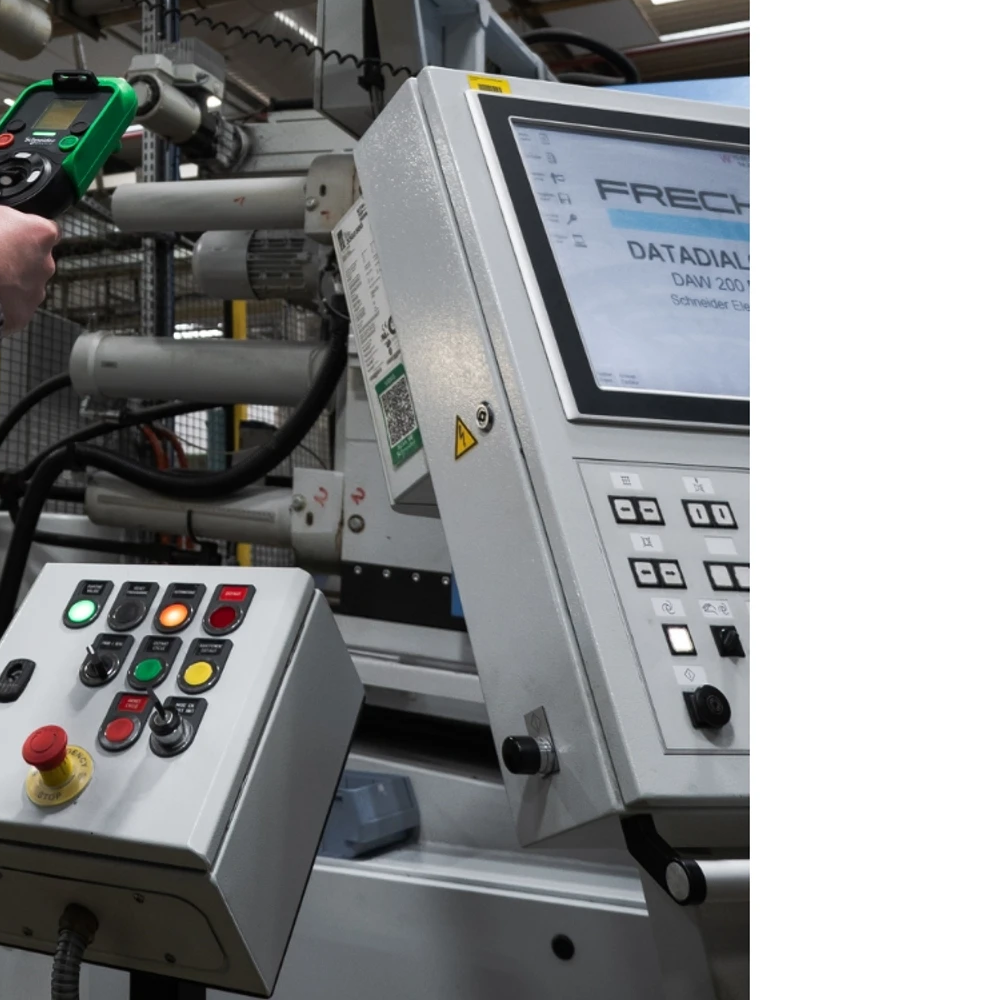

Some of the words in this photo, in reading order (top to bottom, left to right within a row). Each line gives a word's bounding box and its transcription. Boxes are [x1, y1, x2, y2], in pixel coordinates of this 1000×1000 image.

[627, 240, 750, 271] DATADIAL
[671, 271, 712, 290] DAW
[715, 276, 746, 293] 200
[670, 293, 729, 310] Schneider
[37, 791, 62, 801] STOP
